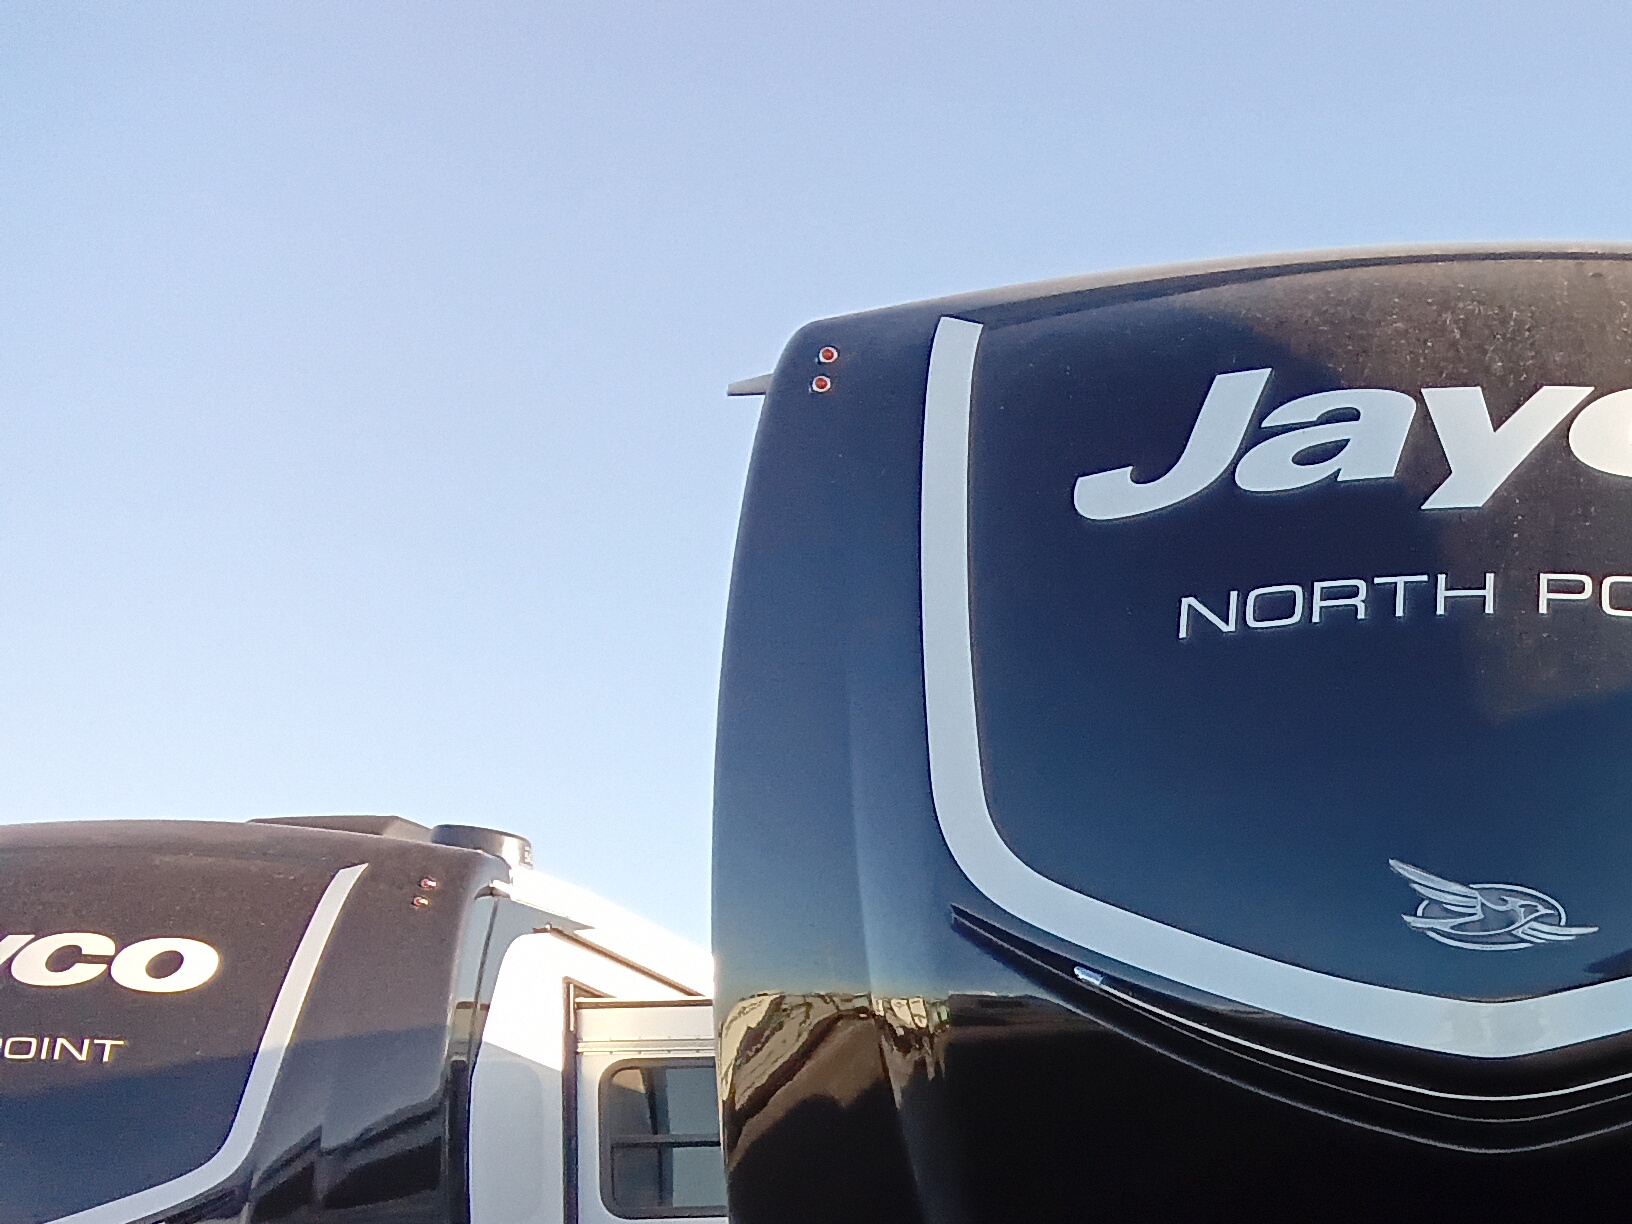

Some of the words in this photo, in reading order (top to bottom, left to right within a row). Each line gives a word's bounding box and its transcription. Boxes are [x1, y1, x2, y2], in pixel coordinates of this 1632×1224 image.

[1178, 572, 1495, 639] NORTH
[0, 932, 220, 993] co
[0, 1036, 125, 1063] OINT
